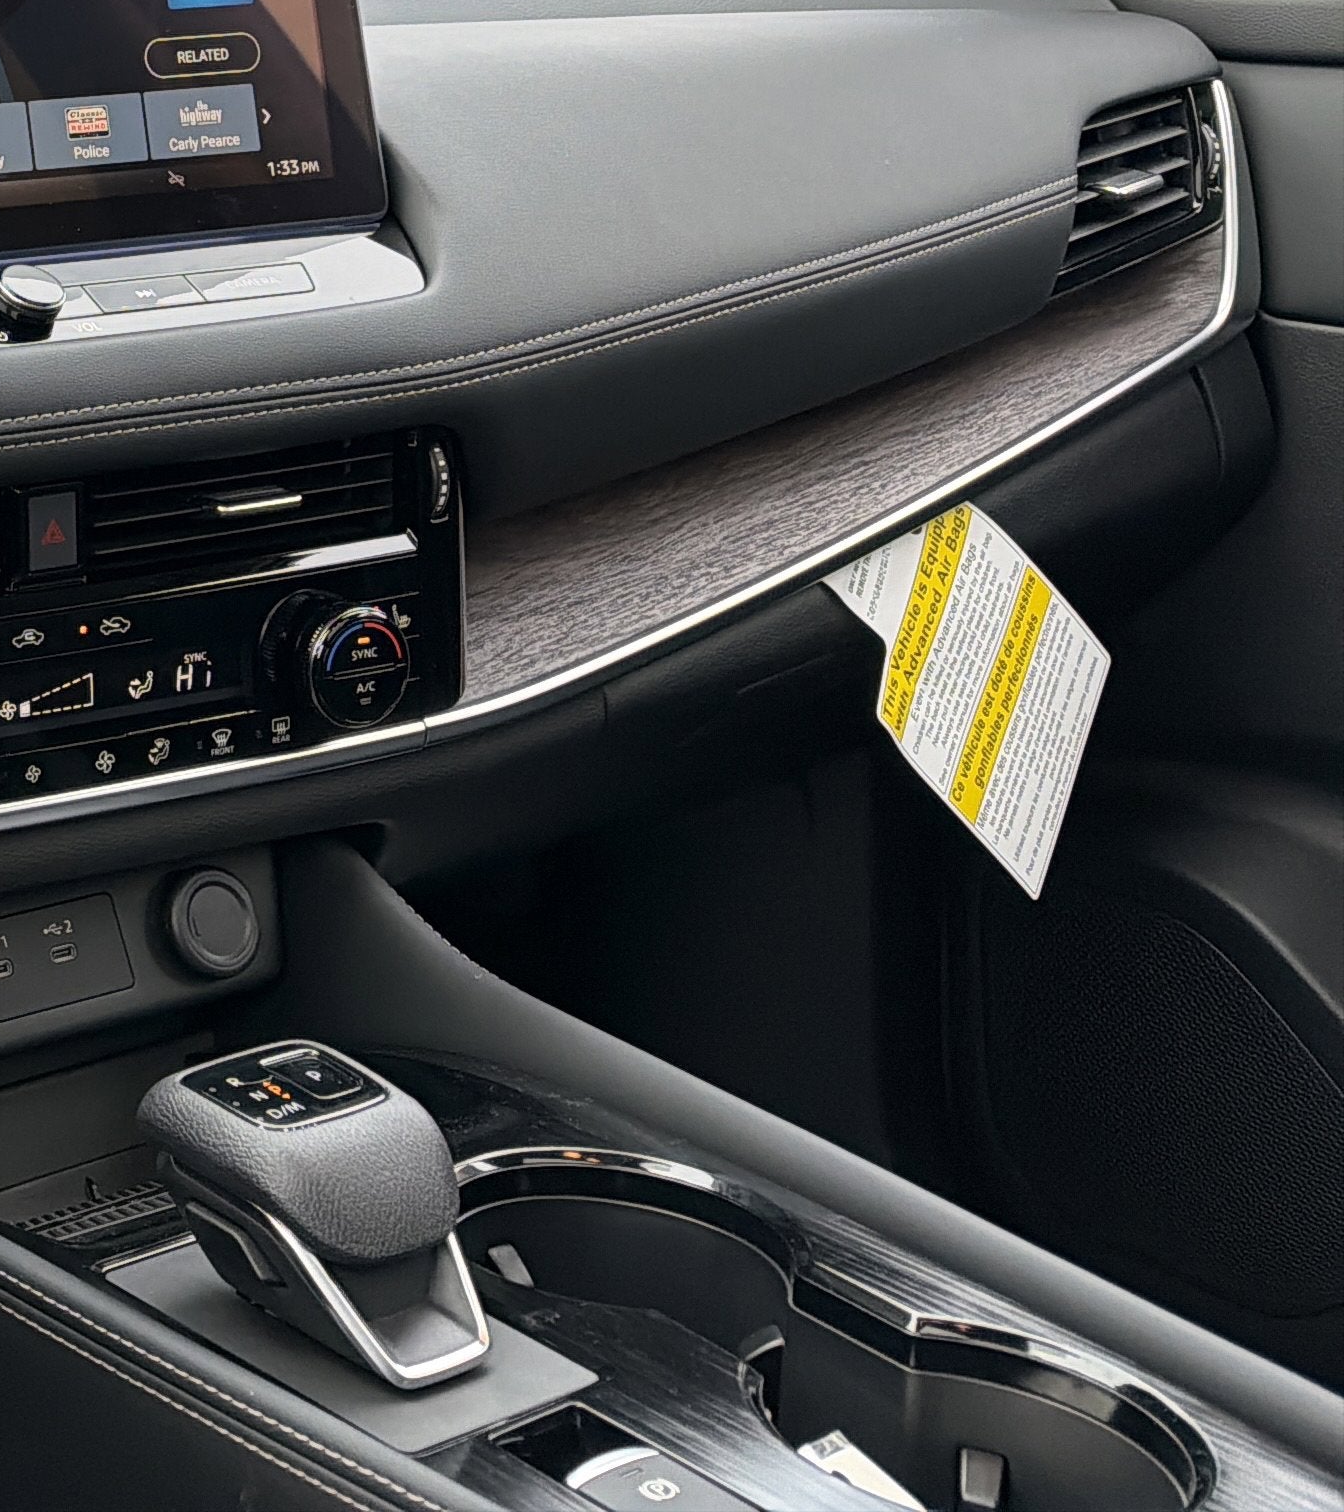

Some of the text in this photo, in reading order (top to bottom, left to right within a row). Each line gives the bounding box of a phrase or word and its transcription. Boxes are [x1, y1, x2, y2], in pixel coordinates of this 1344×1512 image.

[176, 47, 230, 65] RELATED
[179, 107, 222, 127] highway
[73, 144, 111, 160] Police
[168, 135, 241, 153] Carly Pearce
[266, 159, 320, 177] 1:33 PM
[71, 321, 103, 333] VOL
[880, 515, 947, 716] This Vehicle is Equipp
[894, 507, 965, 730] with Advanced Air Bags
[910, 542, 976, 721] Even with Advanced Air Bags
[182, 651, 208, 664] SYNC
[350, 646, 379, 662] SYNC
[355, 680, 377, 695] A/C
[951, 574, 1035, 802] Ce véhicule est doté de coussins
[974, 614, 1037, 790] gonflables perfectionnés
[271, 732, 291, 744] REAR
[210, 744, 235, 756] FRONT
[63, 920, 74, 933] 2
[0, 935, 9, 950] 1
[248, 1090, 270, 1102] N
[265, 1101, 307, 1120] D/M
